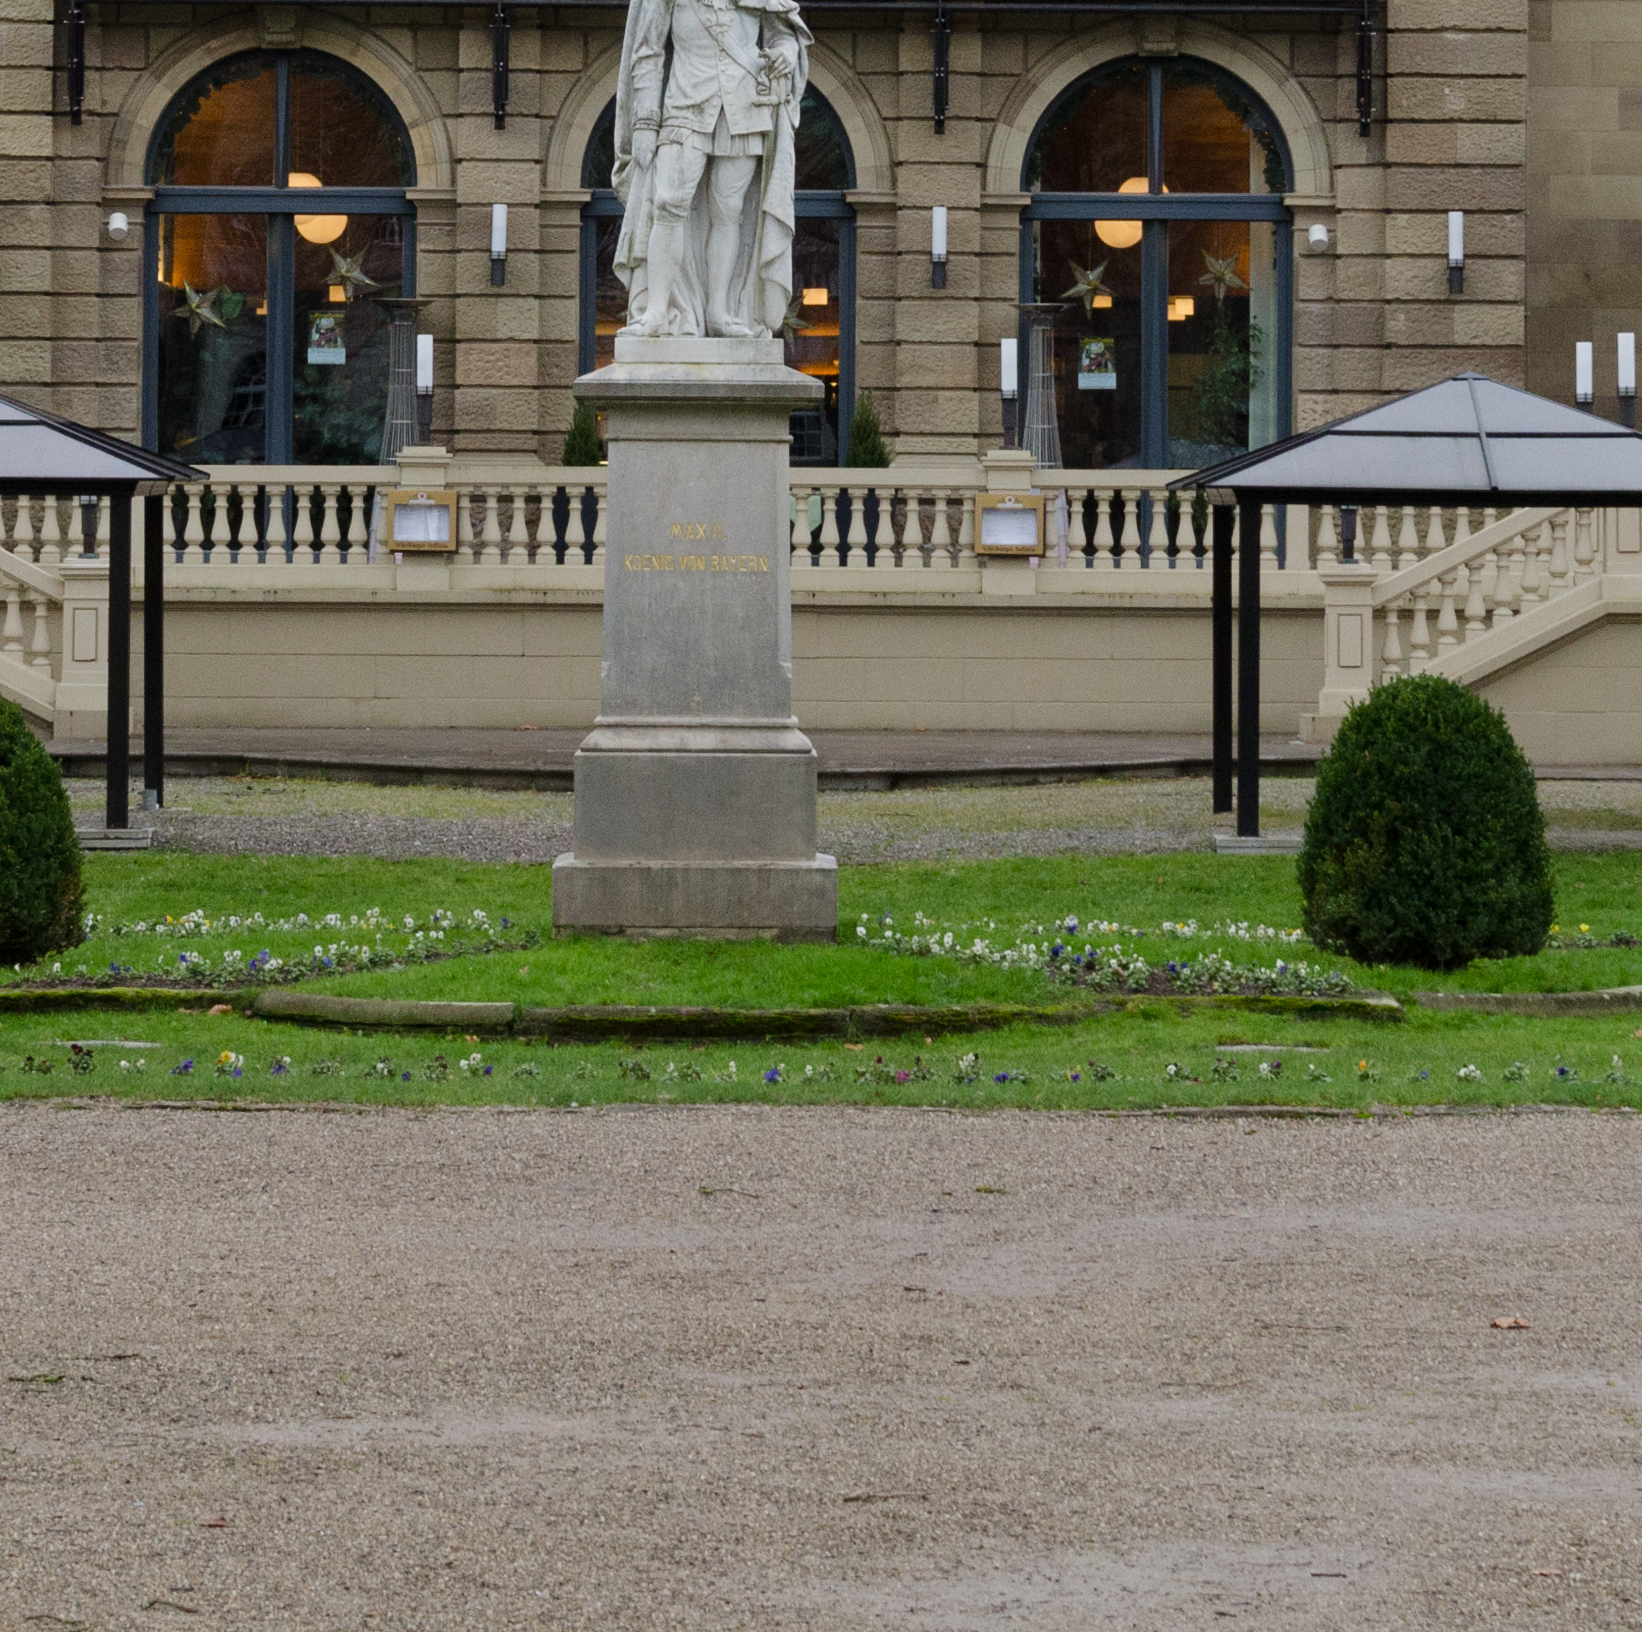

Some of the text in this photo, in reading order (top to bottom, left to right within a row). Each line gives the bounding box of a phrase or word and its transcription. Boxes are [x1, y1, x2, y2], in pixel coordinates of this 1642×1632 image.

[669, 522, 707, 539] MAX
[623, 555, 674, 571] KOENIG
[679, 555, 706, 571] VON
